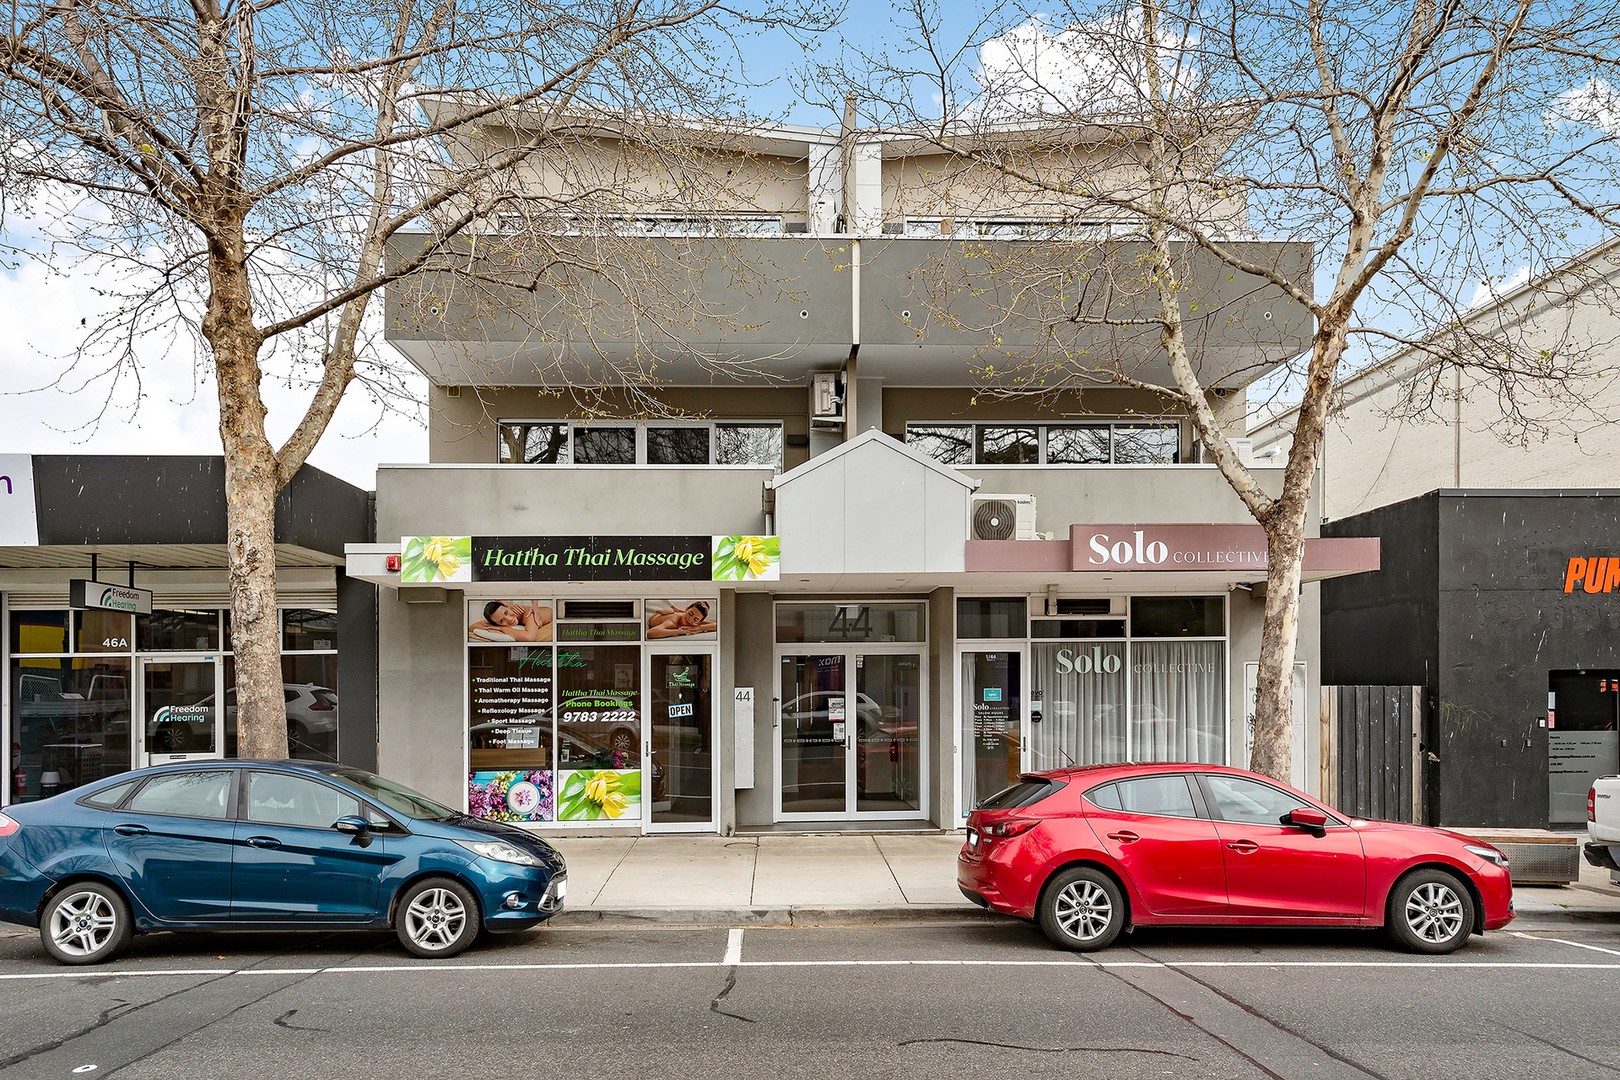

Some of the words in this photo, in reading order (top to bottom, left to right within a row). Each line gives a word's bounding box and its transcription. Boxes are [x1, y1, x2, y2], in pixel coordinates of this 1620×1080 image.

[1088, 530, 1168, 564] Solo
[1173, 551, 1268, 563] COLLECTIVE
[484, 547, 558, 566] Hattha
[564, 548, 612, 566] Thai
[613, 548, 704, 570] Massage
[1563, 557, 1620, 594] PUM
[112, 588, 140, 600] Freedom
[112, 600, 136, 610] Hearing
[828, 606, 873, 638] 44
[102, 638, 128, 648] 46A
[1056, 646, 1121, 674] Solo
[1134, 663, 1215, 674] COLLECTIVE
[736, 691, 750, 702] 44
[594, 700, 633, 708] Bookings
[563, 712, 598, 722] 9783
[601, 711, 636, 722] 2222
[670, 706, 692, 716] OPEN
[170, 714, 205, 723] Hearing
